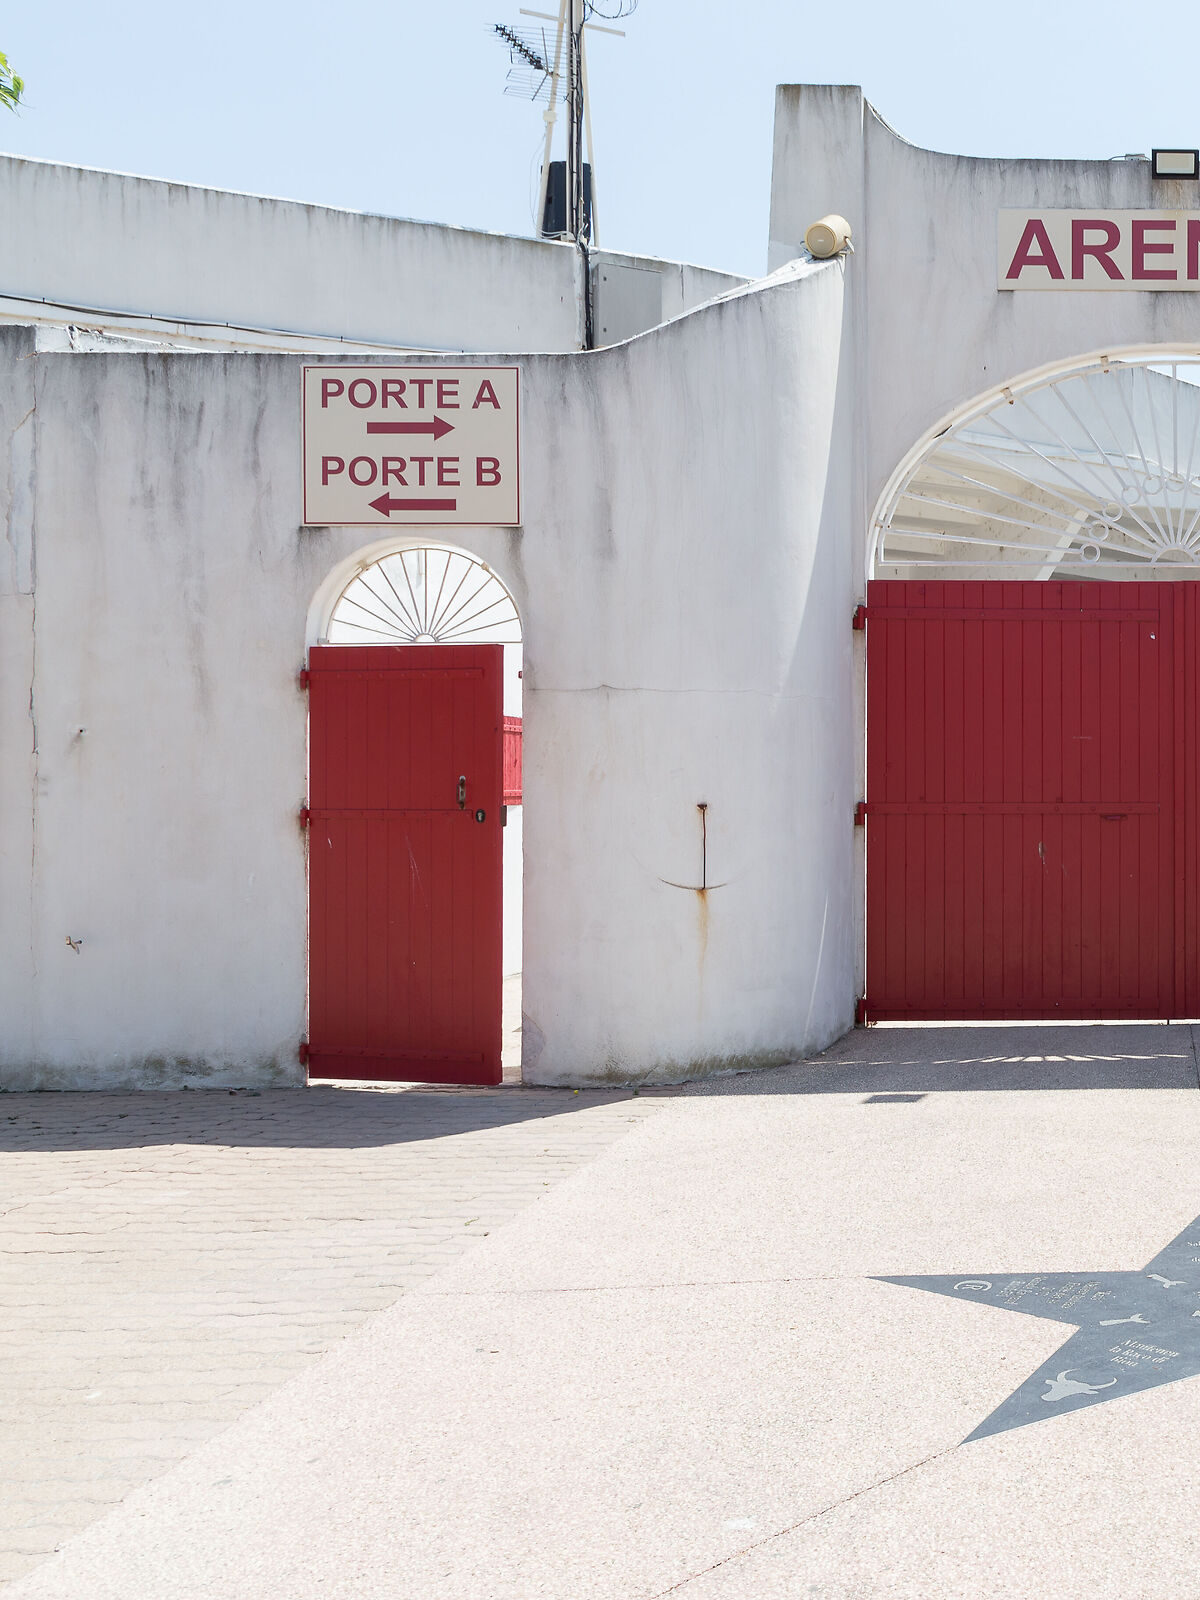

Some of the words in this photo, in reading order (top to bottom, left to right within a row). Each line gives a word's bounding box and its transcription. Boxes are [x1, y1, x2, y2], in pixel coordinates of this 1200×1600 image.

[321, 378, 460, 409] PORTE
[472, 379, 502, 410] A
[321, 456, 461, 487] PORTE
[476, 456, 502, 487] B
